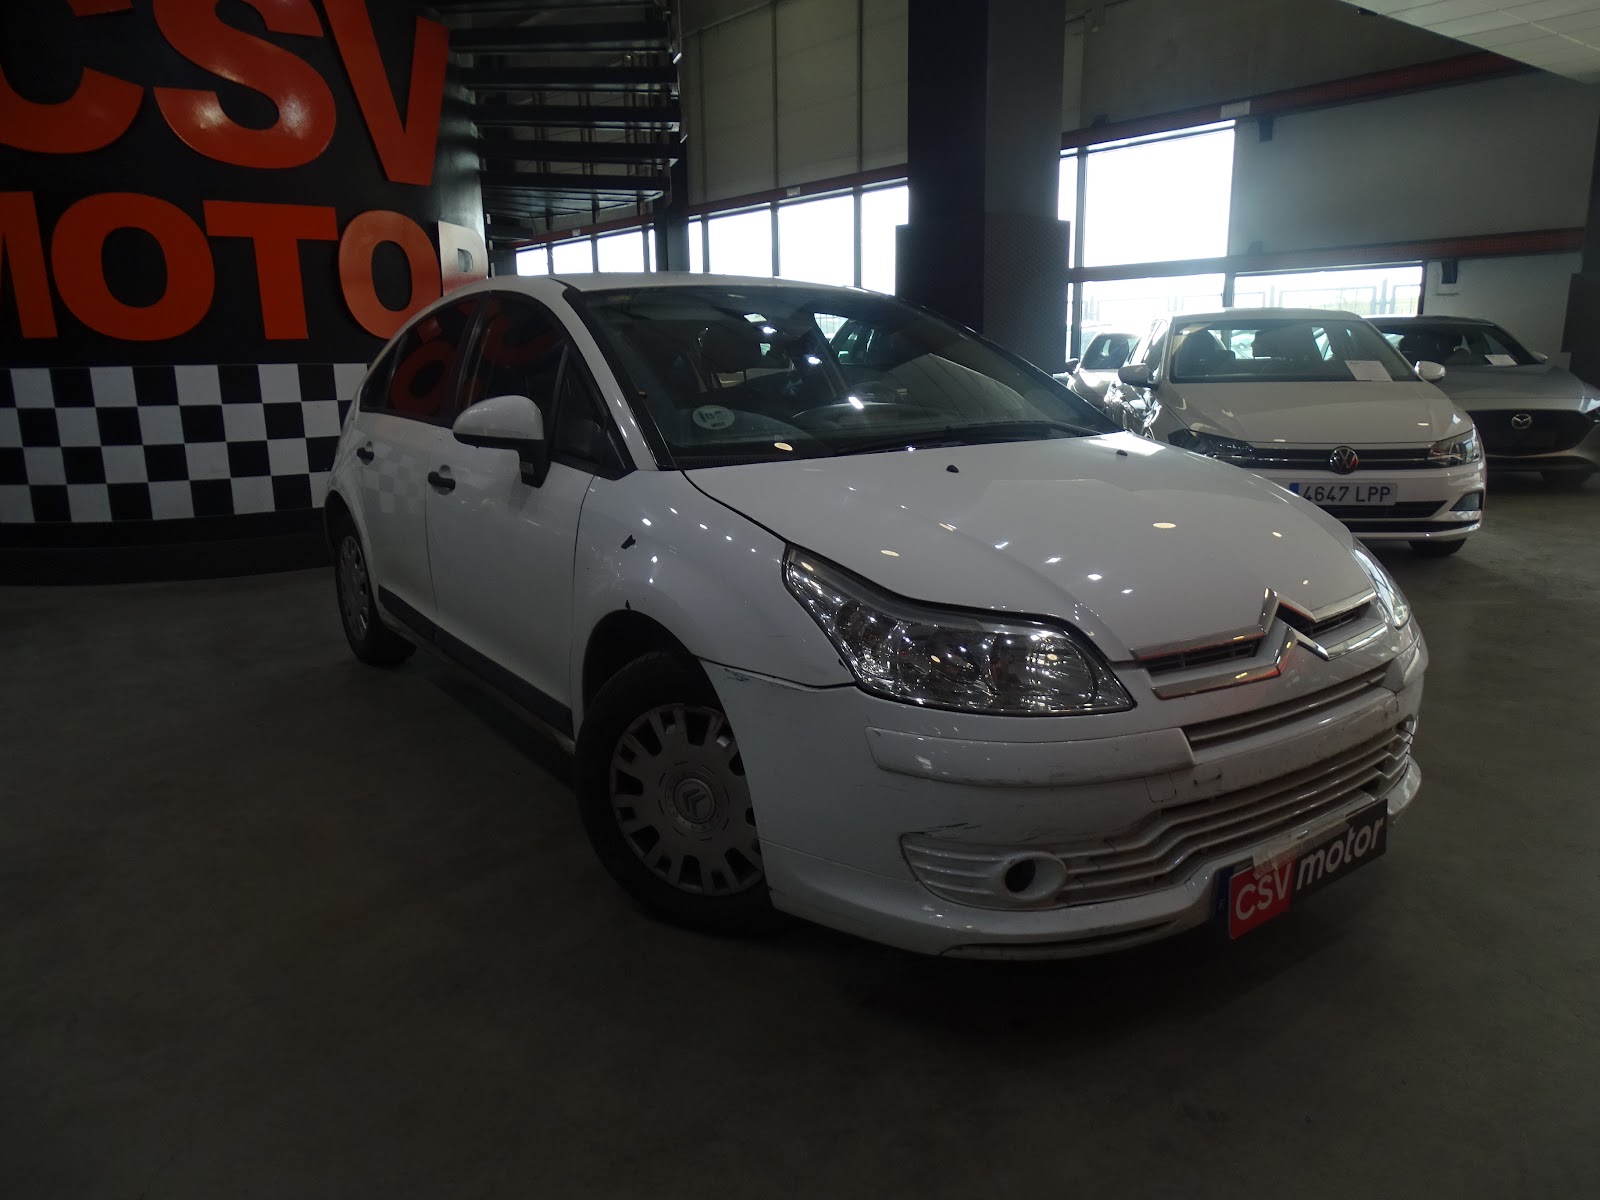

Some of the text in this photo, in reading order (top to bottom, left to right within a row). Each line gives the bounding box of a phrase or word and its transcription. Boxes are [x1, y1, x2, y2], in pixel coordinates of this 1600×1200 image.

[0, 0, 449, 187] CSV
[1302, 485, 1391, 502] 4647 LPP
[1235, 816, 1385, 921] CSV motor
